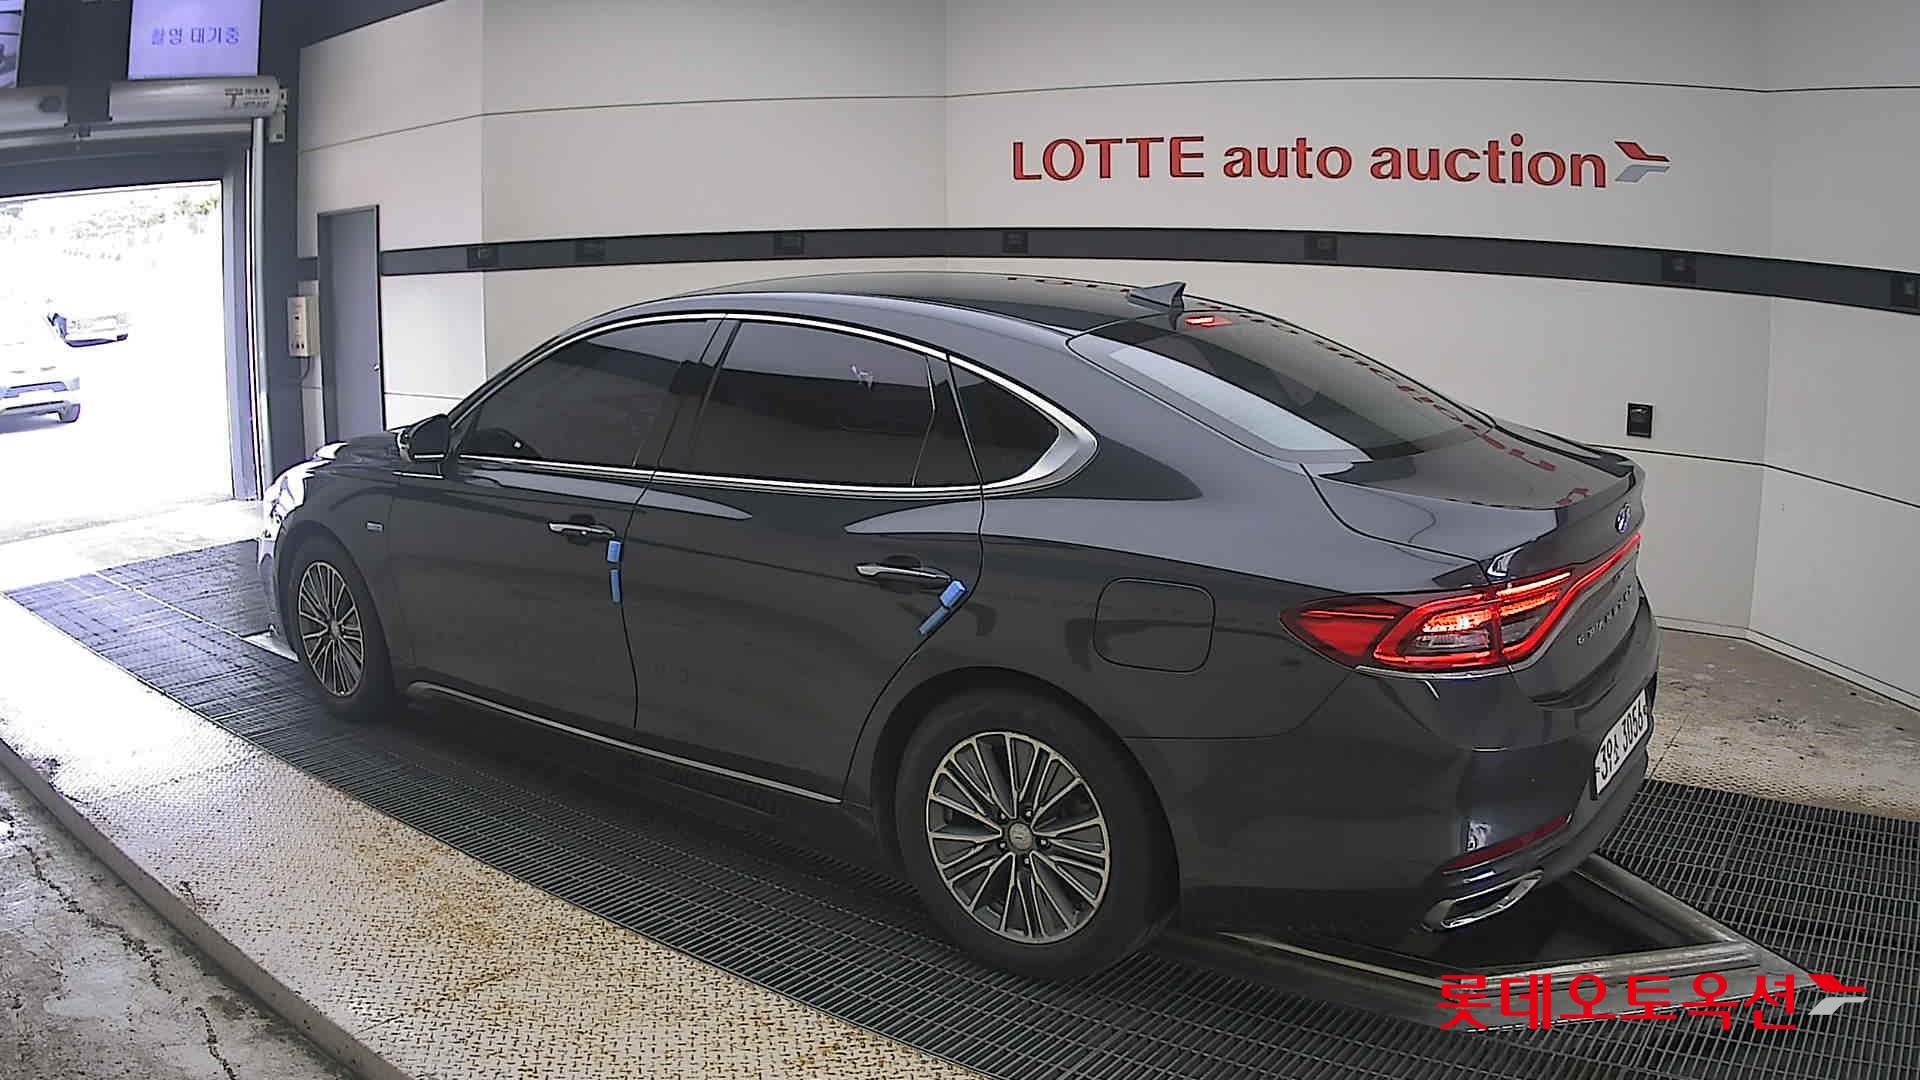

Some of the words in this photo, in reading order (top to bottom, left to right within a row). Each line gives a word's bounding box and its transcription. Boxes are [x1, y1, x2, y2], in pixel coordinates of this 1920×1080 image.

[191, 27, 240, 45] 대기중
[1012, 136, 1204, 180] LOTTE
[1223, 138, 1352, 180] auto
[1370, 133, 1607, 188] auction
